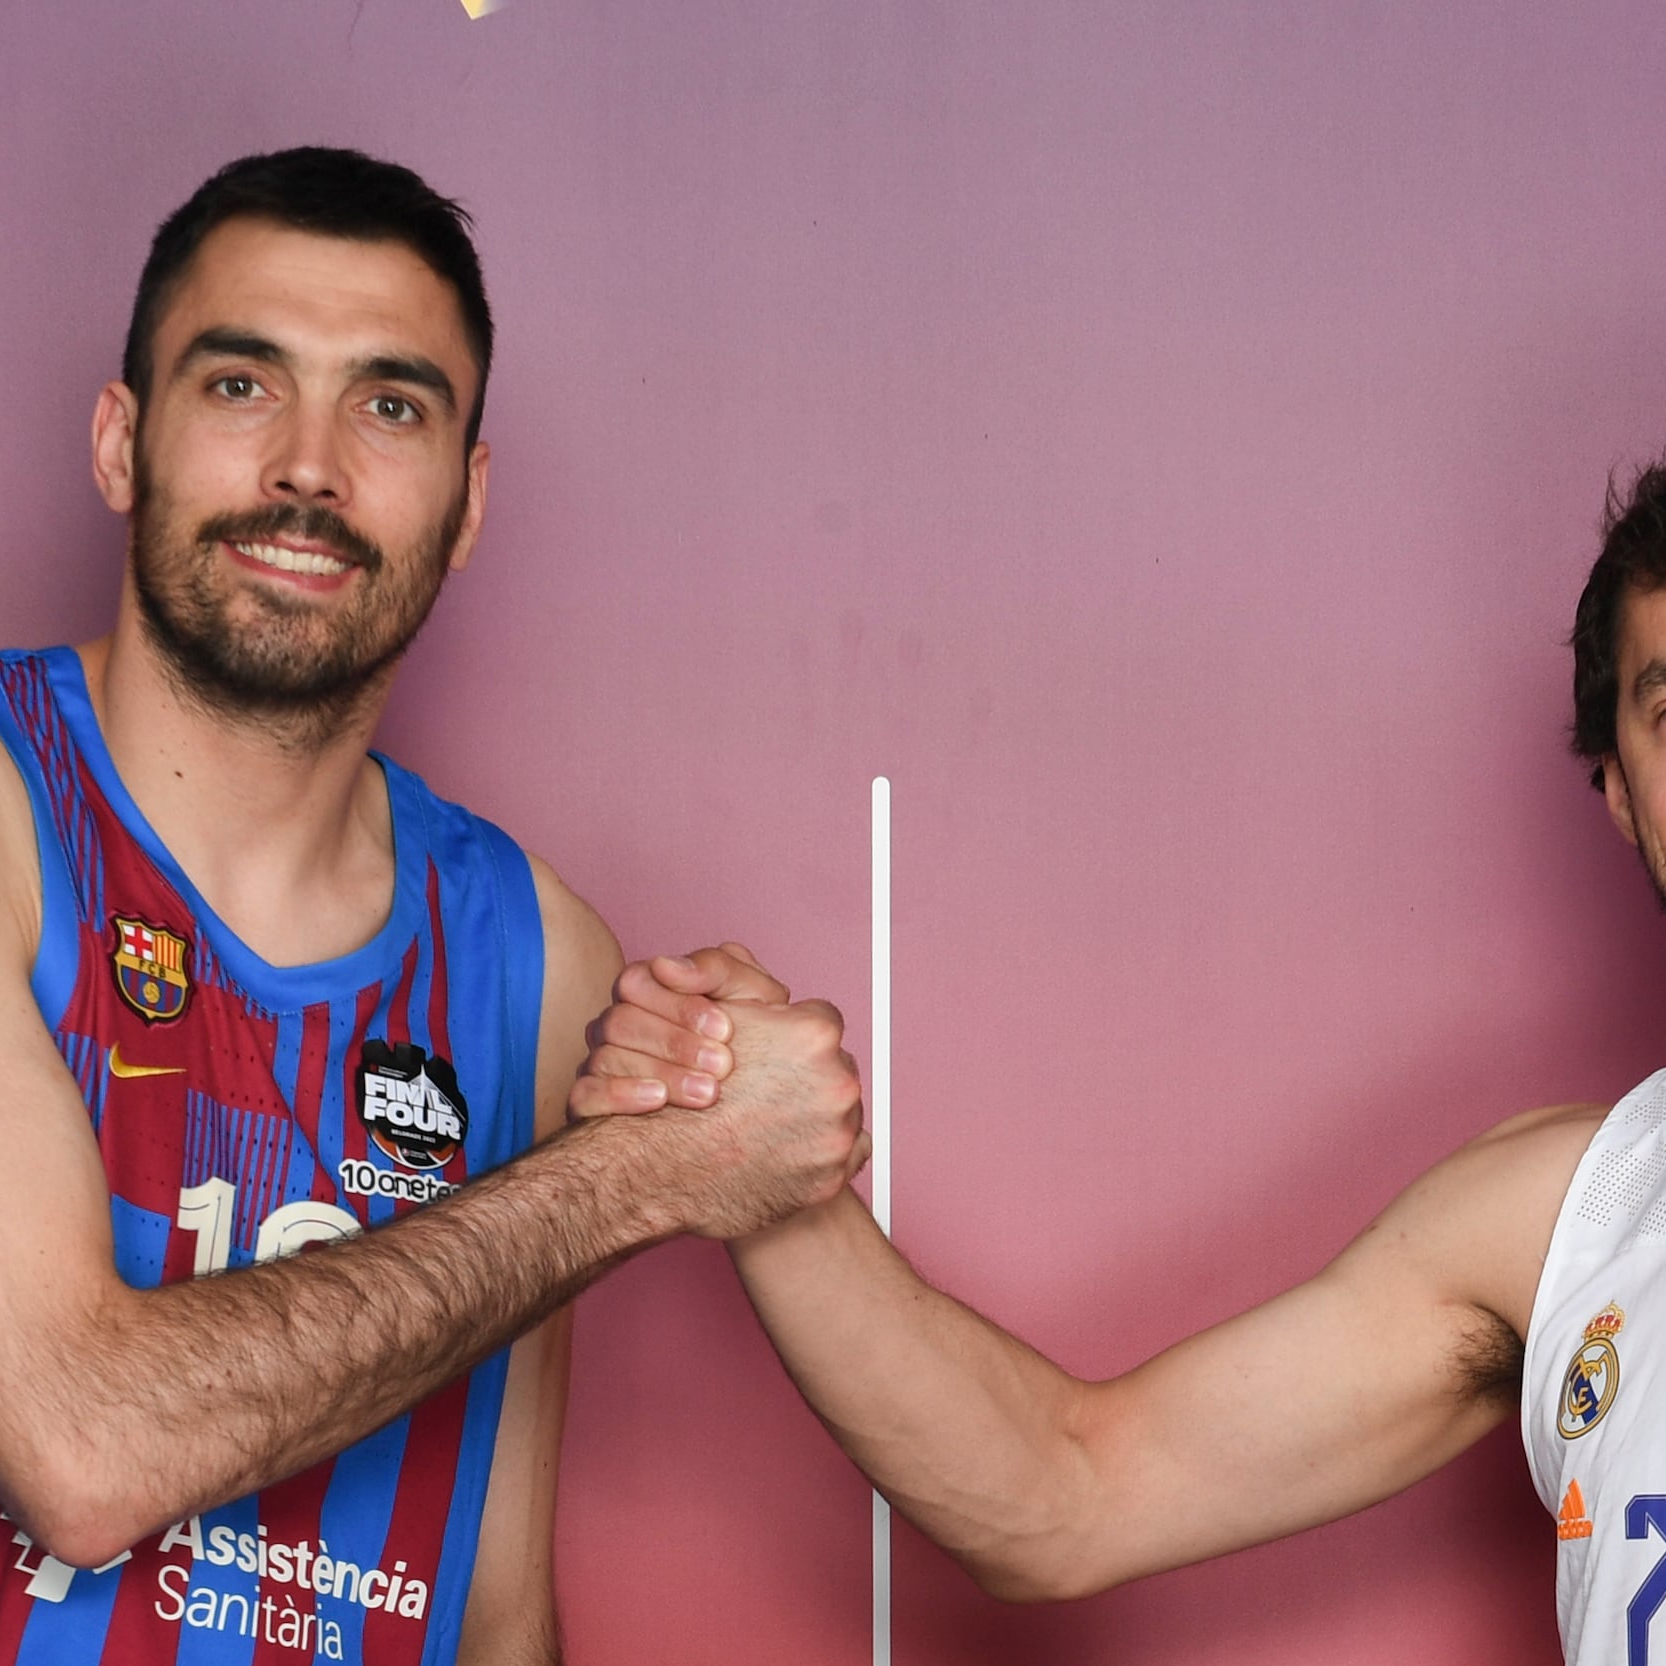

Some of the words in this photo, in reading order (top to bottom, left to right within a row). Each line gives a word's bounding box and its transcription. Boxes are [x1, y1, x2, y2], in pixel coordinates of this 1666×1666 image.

[364, 1095, 462, 1140] FOUR
[154, 1564, 344, 1661] Sanitària
[157, 1514, 428, 1621] Assistència
